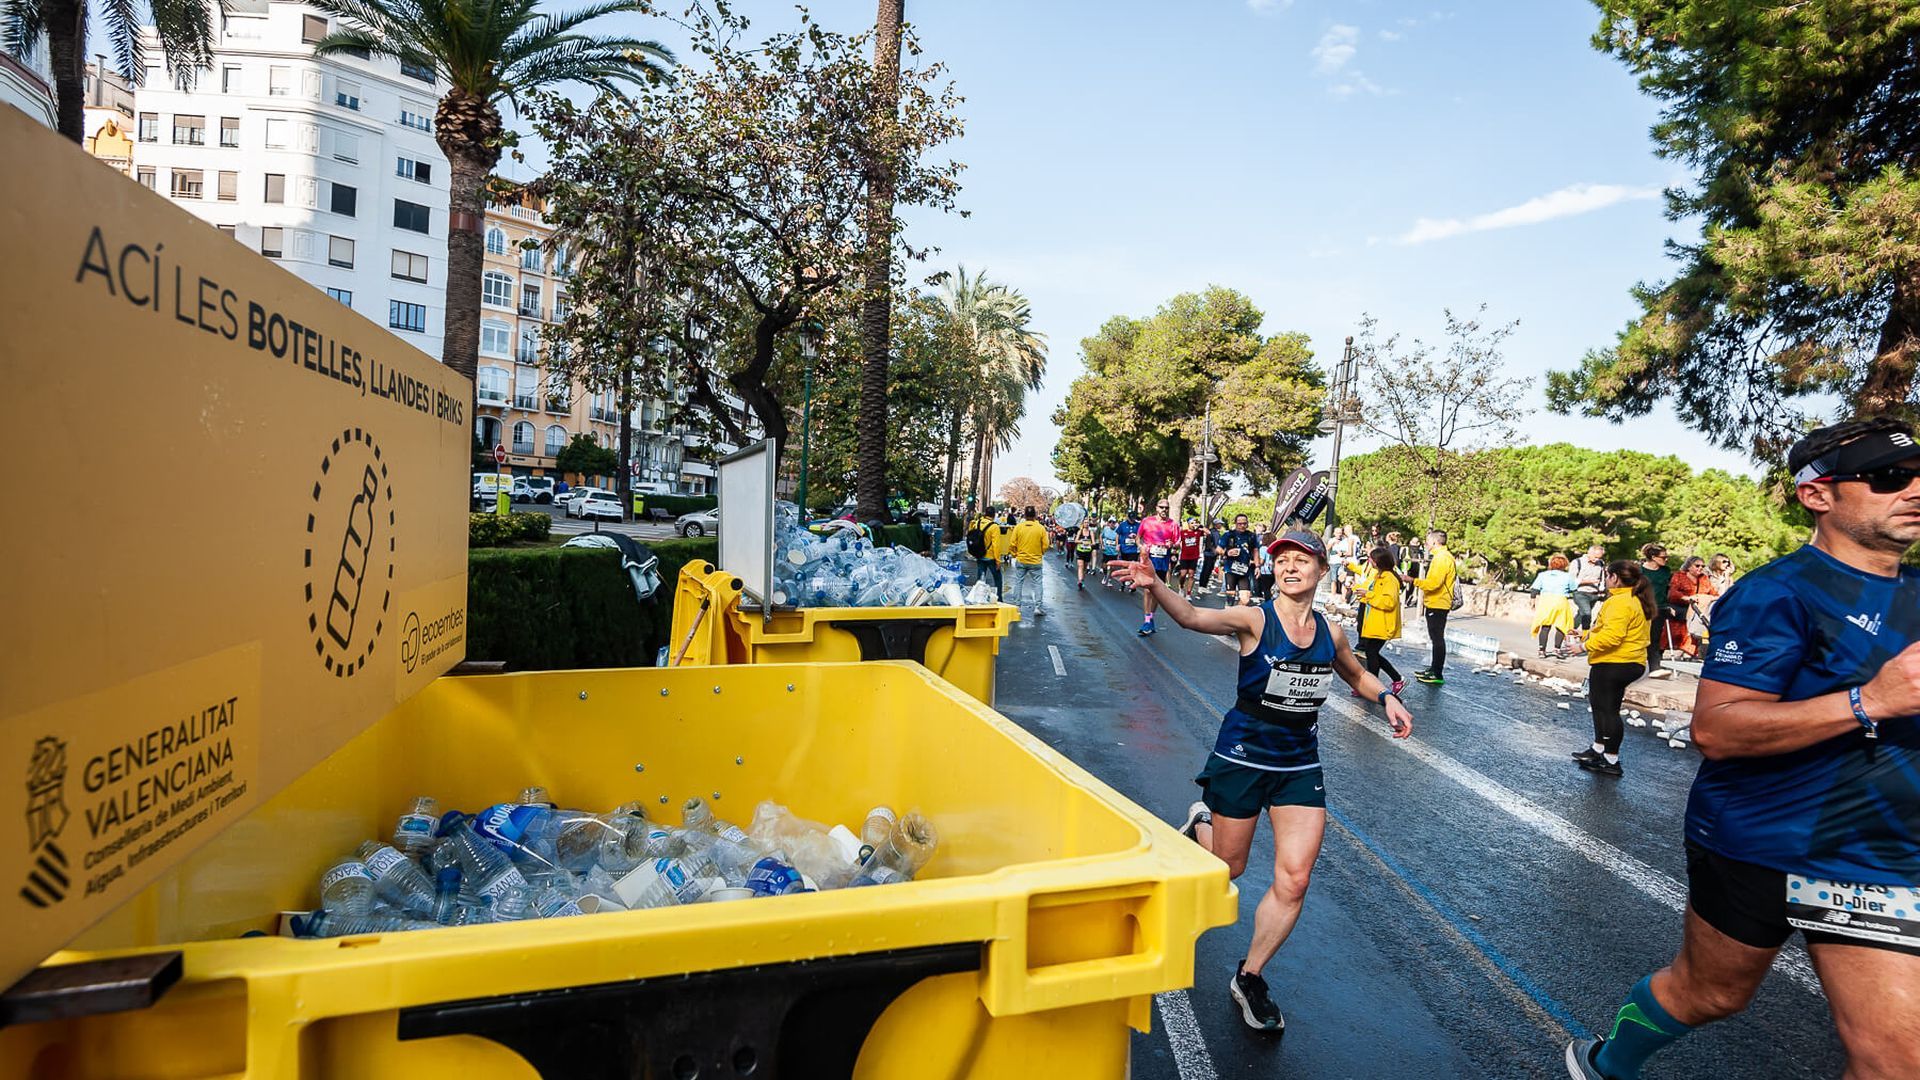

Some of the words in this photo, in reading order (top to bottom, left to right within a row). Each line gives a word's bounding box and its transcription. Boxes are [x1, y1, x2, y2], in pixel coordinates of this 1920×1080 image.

[75, 225, 164, 312] ACÍ
[175, 265, 239, 340] LES
[248, 300, 366, 396] BOTELLES,
[370, 359, 430, 414] LLANDES
[431, 389, 435, 416] I
[437, 391, 463, 426] BRIKS
[422, 607, 463, 645] ecoembes
[1288, 688, 1315, 698] Marley
[1289, 677, 1320, 688] 21842
[82, 696, 238, 794] GENERALITAT
[85, 737, 233, 840] VALENCIANA
[127, 806, 209, 869] Infraestructures
[209, 800, 214, 816] i
[215, 780, 248, 812] Territori
[155, 808, 168, 828] de
[170, 790, 195, 819] Medi
[1832, 893, 1887, 912] D-Dier
